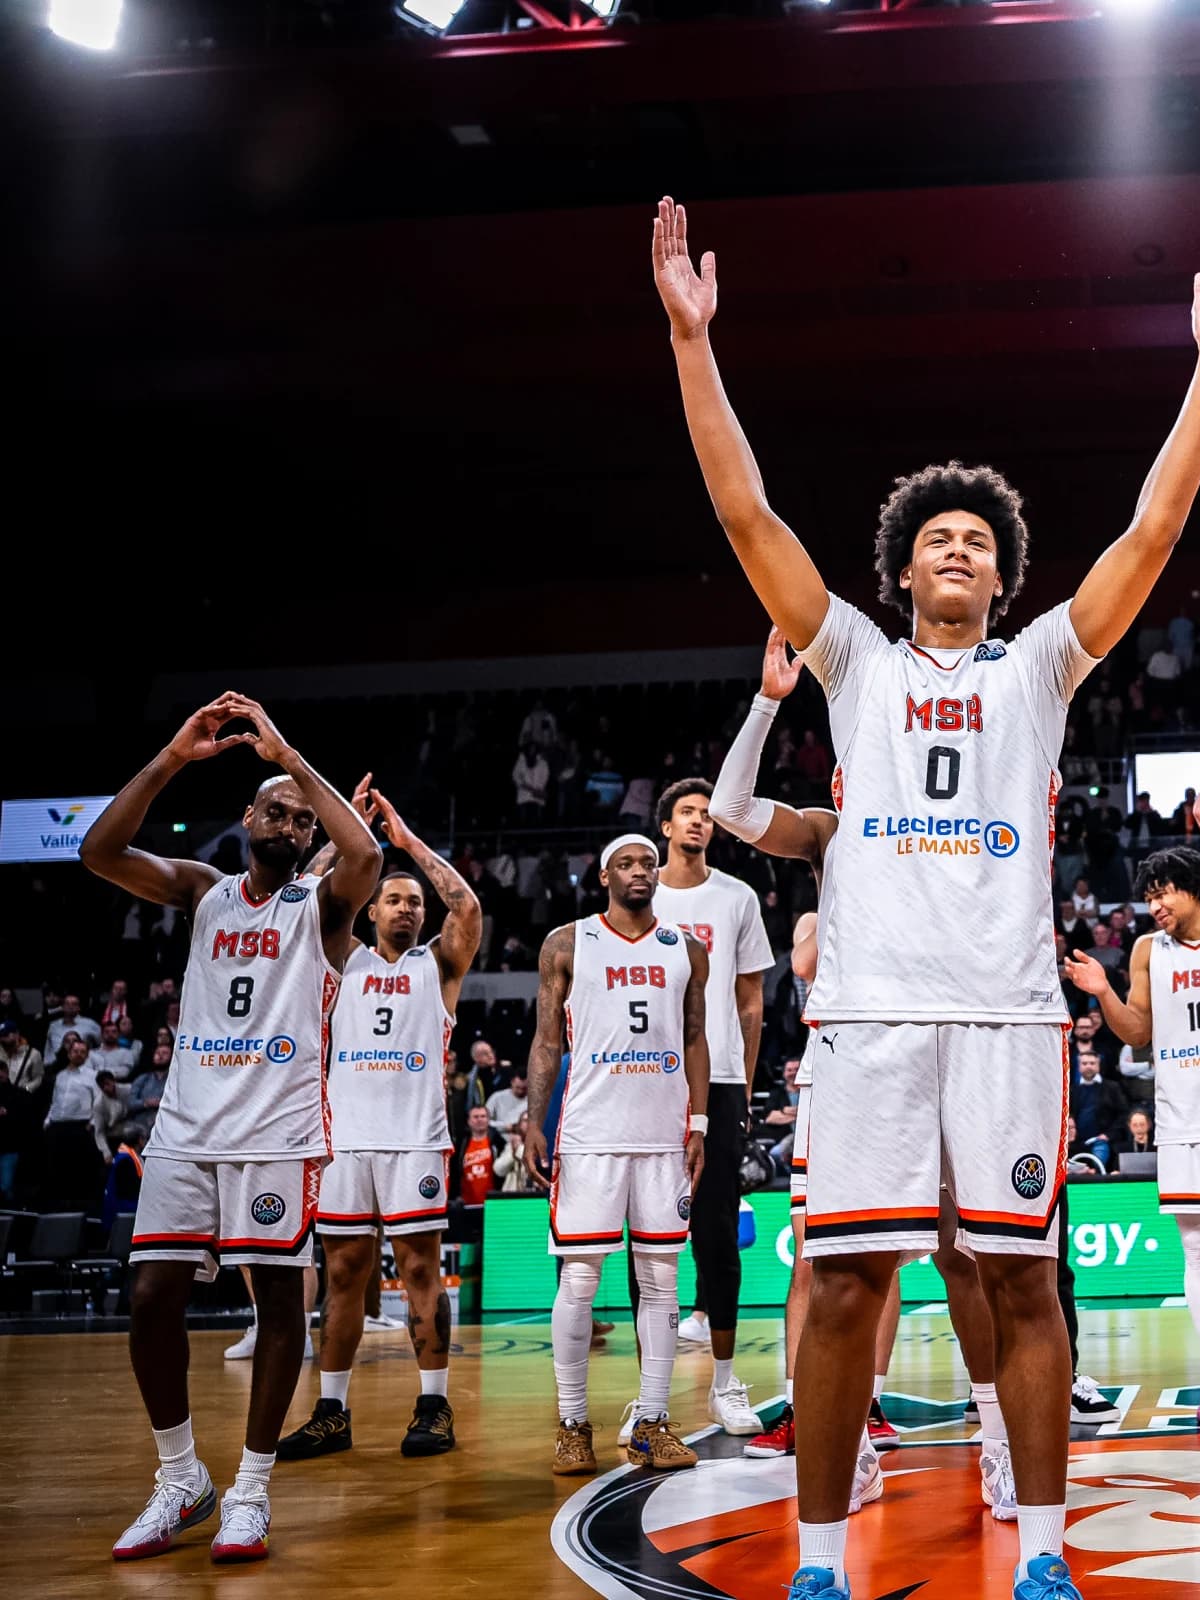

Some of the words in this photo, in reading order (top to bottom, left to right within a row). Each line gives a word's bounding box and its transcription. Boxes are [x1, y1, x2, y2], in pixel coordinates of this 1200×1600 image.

[905, 692, 984, 733] MSB
[925, 746, 960, 799] 0
[863, 816, 981, 837] E.Leclerc
[897, 838, 912, 854] LE
[918, 837, 980, 855] MANS
[212, 928, 280, 960] MSB
[362, 974, 411, 996] MSB
[606, 966, 666, 990] MSB
[227, 976, 254, 1017] 8
[373, 1007, 393, 1035] 3
[629, 1001, 648, 1034] 5
[180, 1035, 264, 1052] E.Leclerc
[200, 1054, 214, 1066] LE
[219, 1052, 261, 1066] MANS
[355, 1062, 365, 1072] LE
[368, 1062, 402, 1071] MANS
[610, 1065, 622, 1074] LE
[626, 1064, 660, 1074] MANS
[1180, 1059, 1190, 1068] LE
